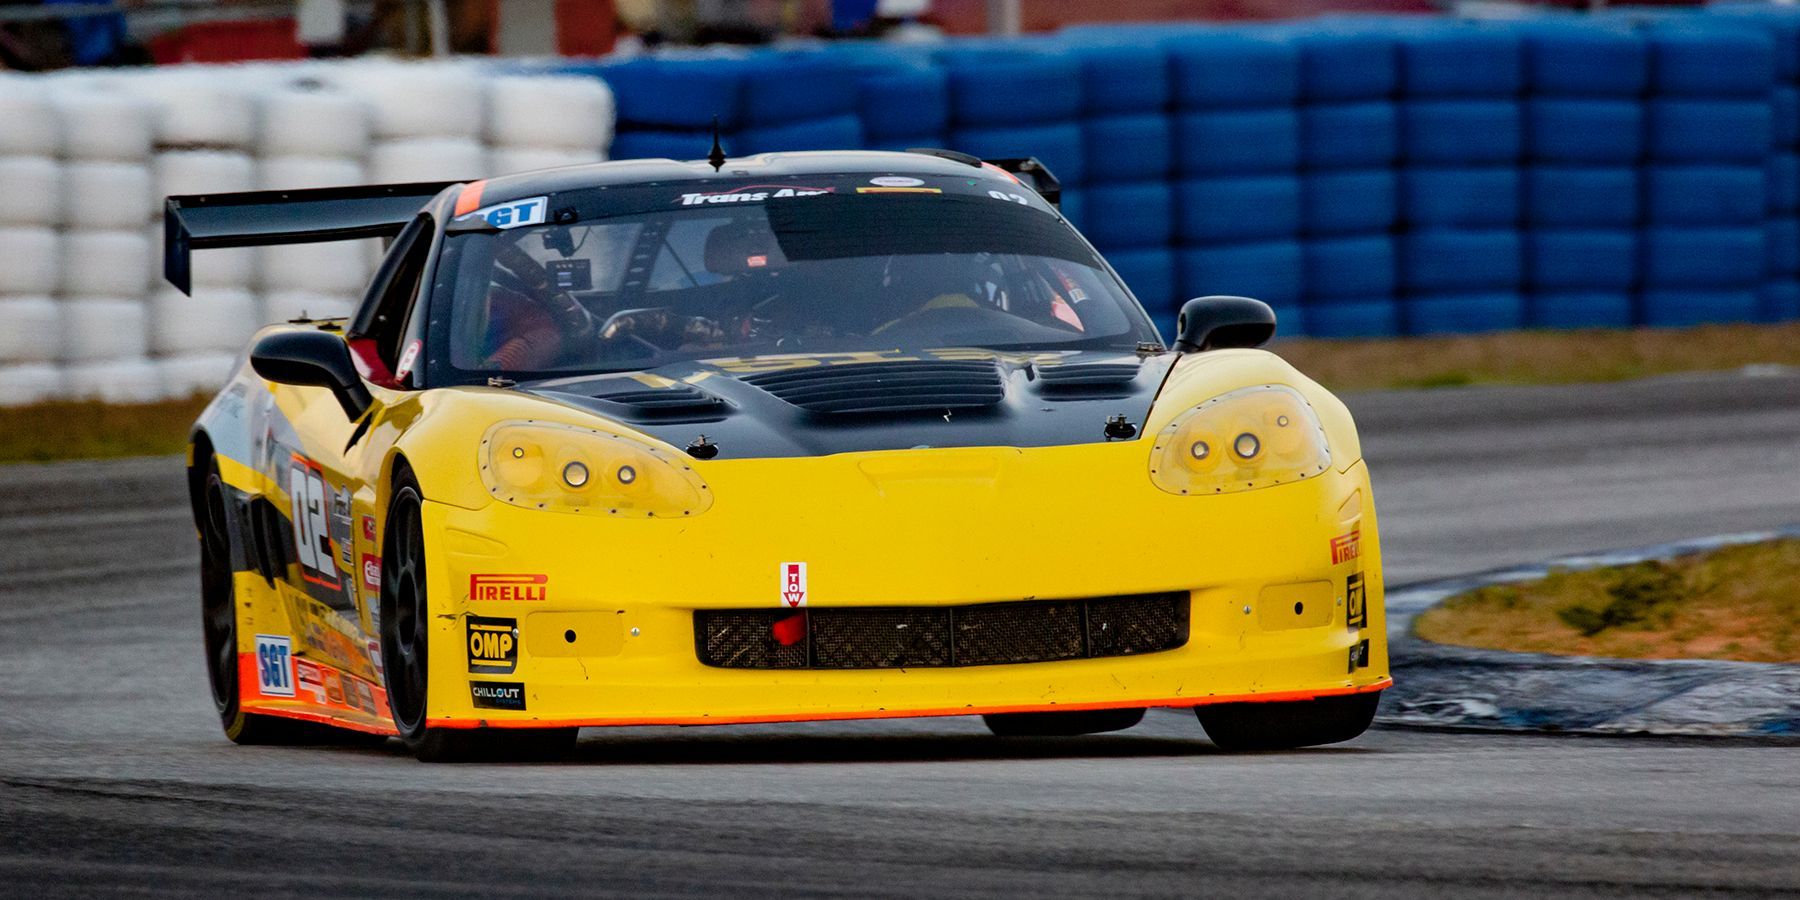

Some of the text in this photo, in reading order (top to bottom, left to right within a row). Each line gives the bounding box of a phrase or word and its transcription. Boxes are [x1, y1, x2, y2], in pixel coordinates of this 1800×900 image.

[681, 192, 768, 206] Trans
[480, 202, 538, 228] GT
[291, 468, 338, 580] 02
[470, 574, 548, 601] PIRELLI
[787, 573, 800, 603] TOW
[470, 631, 512, 659] OMP
[260, 643, 289, 688] SGT
[473, 687, 519, 698] CHILLOUT
